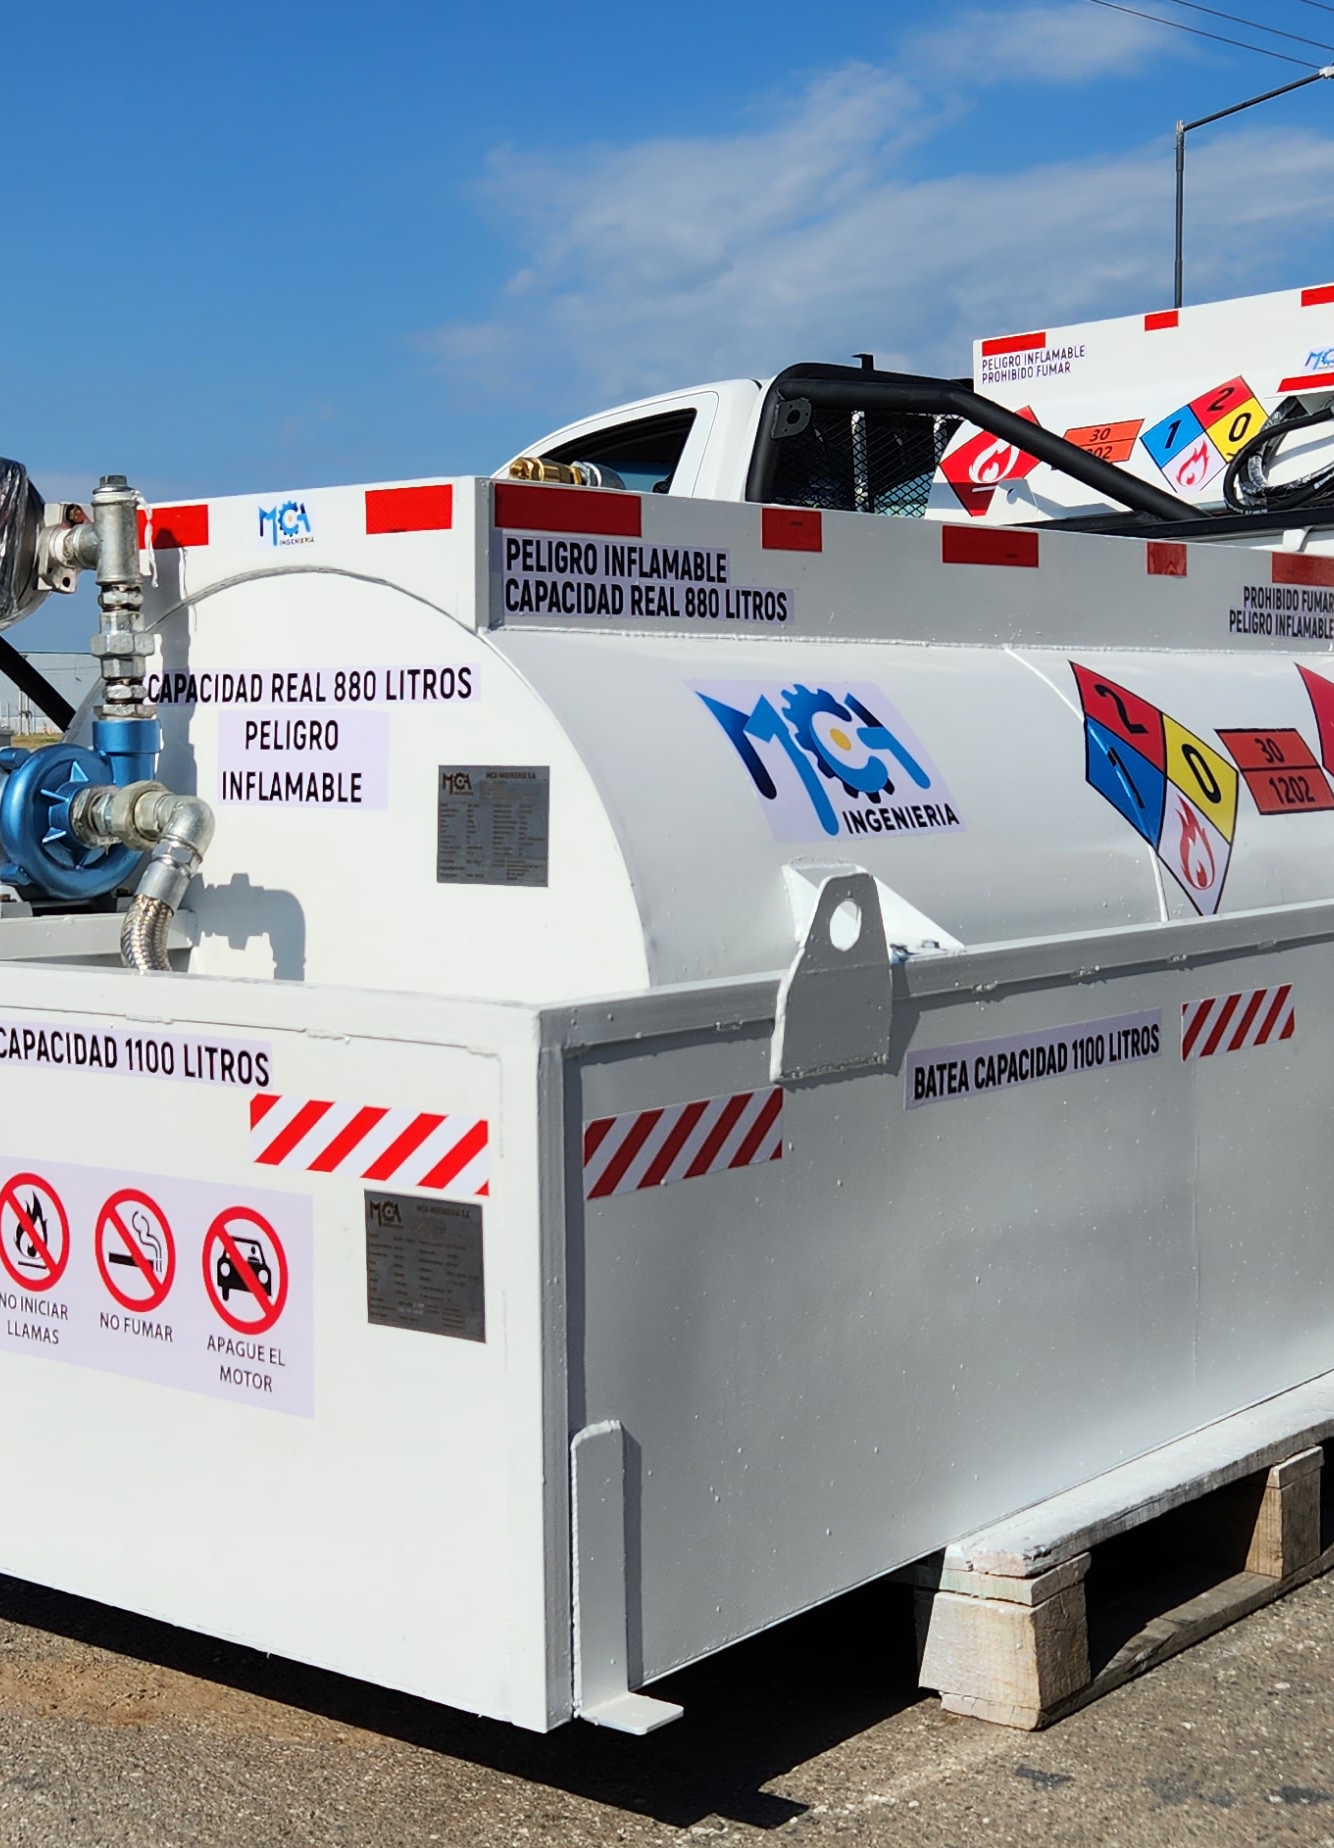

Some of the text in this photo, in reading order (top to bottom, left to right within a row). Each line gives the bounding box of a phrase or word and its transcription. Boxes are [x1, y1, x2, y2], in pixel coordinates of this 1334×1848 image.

[982, 345, 1086, 372] PELIGRO INFLAMABLE
[982, 361, 1071, 384] PROHIBIDO FUMAR
[1206, 387, 1235, 412] 2
[1089, 428, 1111, 442] 30
[1164, 419, 1182, 448] 1
[1228, 412, 1252, 442] 0
[258, 500, 311, 546] MCA
[506, 538, 727, 583] PELIGRO INFLAMABLE
[505, 578, 787, 622] CAPACIDAD REAL 880 LITROS
[1243, 586, 1334, 613] PROHIBIDO FUMAR
[1229, 609, 1334, 639] PELIGRO INFLAMABLE
[147, 667, 473, 704] CAPACIDAD REAL 880 LITROS
[1094, 684, 1149, 734] 2
[245, 720, 339, 750] PELIGRO
[695, 684, 931, 836] MCA
[1255, 738, 1284, 763] 30
[222, 771, 362, 803] INFLAMABLE
[1107, 746, 1145, 809] 1
[1181, 743, 1221, 804] 0
[1269, 775, 1315, 805] 1202
[842, 803, 960, 834] INGENIERIA
[125, 1038, 175, 1075] 1100
[183, 1044, 269, 1087] LITROS
[914, 1023, 1159, 1100] BATEA CAPACIDAD 1100 LITROS
[20, 1296, 68, 1320] INICIAR
[7, 1320, 59, 1345] LLAMAS
[99, 1312, 173, 1342] NO FUMAR
[207, 1334, 286, 1366] APAGUE EL
[219, 1365, 272, 1392] MOTOR
